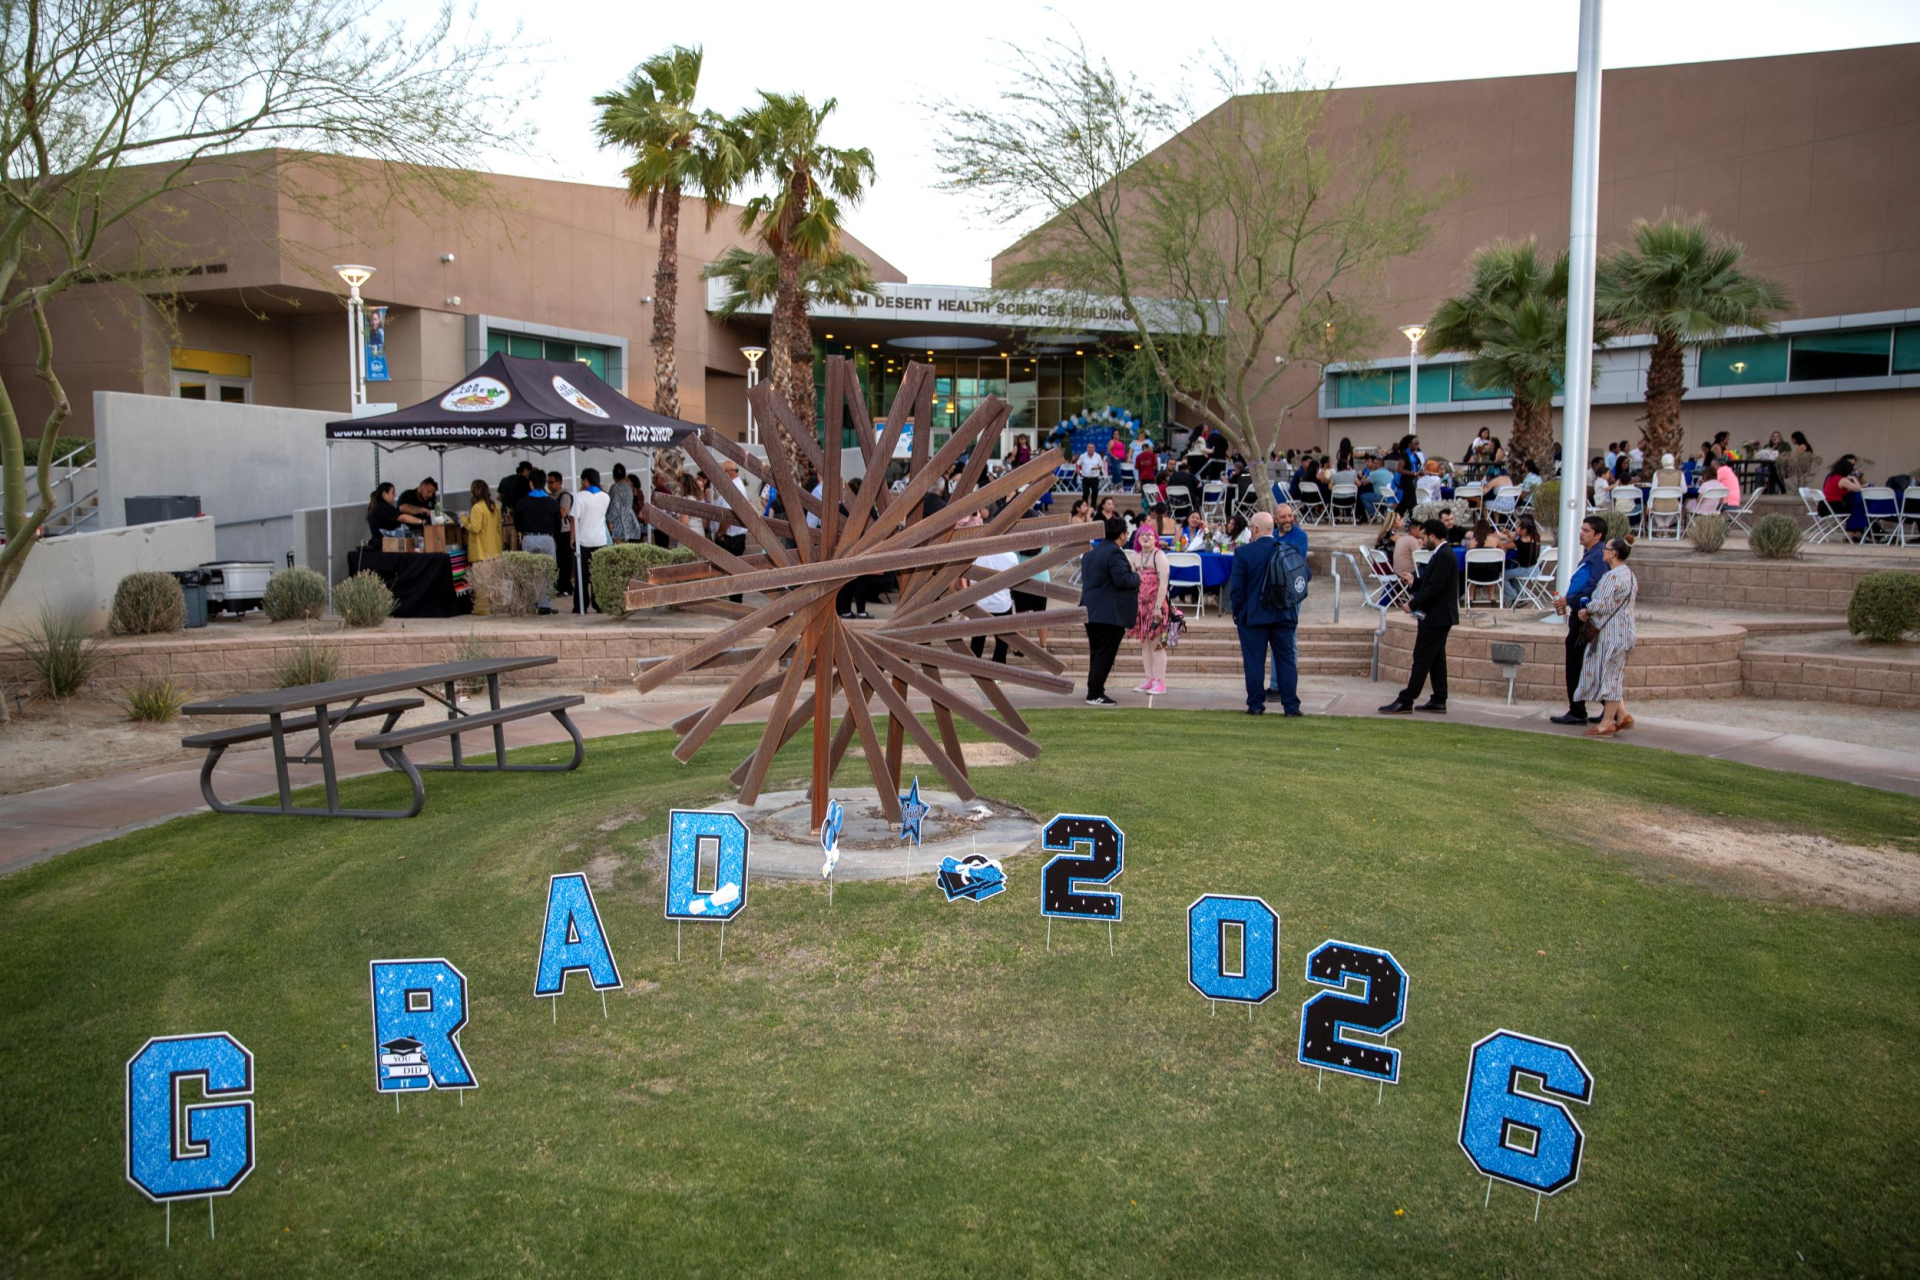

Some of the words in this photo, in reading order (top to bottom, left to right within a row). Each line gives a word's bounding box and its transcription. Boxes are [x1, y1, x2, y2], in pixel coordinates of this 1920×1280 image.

[875, 296, 932, 311] DESERT
[938, 299, 990, 314] HEALTH
[996, 302, 1065, 317] SCIENCES
[1071, 306, 1131, 321] BUILDING
[333, 426, 507, 438] www.lascarretastacoshop.org
[623, 424, 649, 442] TACO
[650, 426, 673, 442] SHOP
[403, 1066, 422, 1074] DID
[400, 1079, 411, 1088] IT
